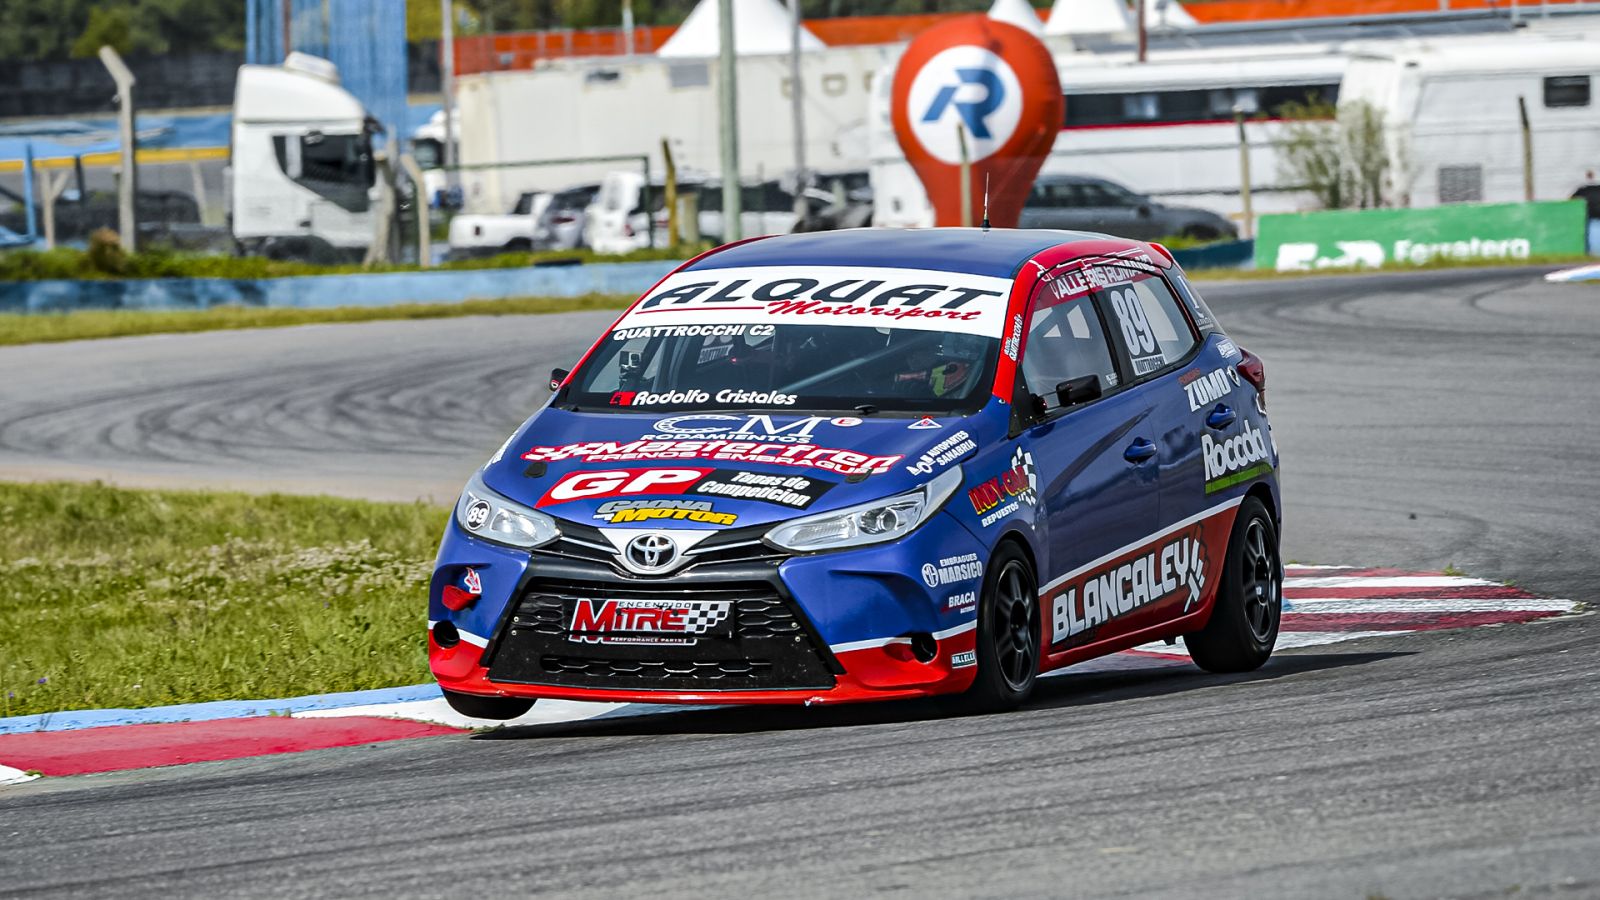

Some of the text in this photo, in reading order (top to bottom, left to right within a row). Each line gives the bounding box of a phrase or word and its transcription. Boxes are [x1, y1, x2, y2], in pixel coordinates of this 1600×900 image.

[642, 278, 1004, 310] ALQUAT
[767, 299, 982, 320] Motorsport
[1110, 288, 1155, 356] 89
[613, 325, 776, 341] QUATTROCCHI C2
[632, 389, 797, 406] Rodolfo Cristales
[640, 433, 812, 444] RODAMIENTOS
[927, 430, 969, 457] AUTOPARTES
[587, 452, 697, 461] FRENOS
[936, 439, 977, 466] SANABRIA
[550, 469, 703, 500] GP
[731, 471, 811, 490] Tapas de
[467, 507, 489, 523] 89
[597, 500, 713, 514] GAONA
[610, 508, 738, 525] MOTOR
[981, 501, 1020, 528] REPUESTOS
[938, 560, 983, 585] MARSICO
[948, 591, 976, 608] BRACA
[1051, 536, 1189, 645] BLANCALEY
